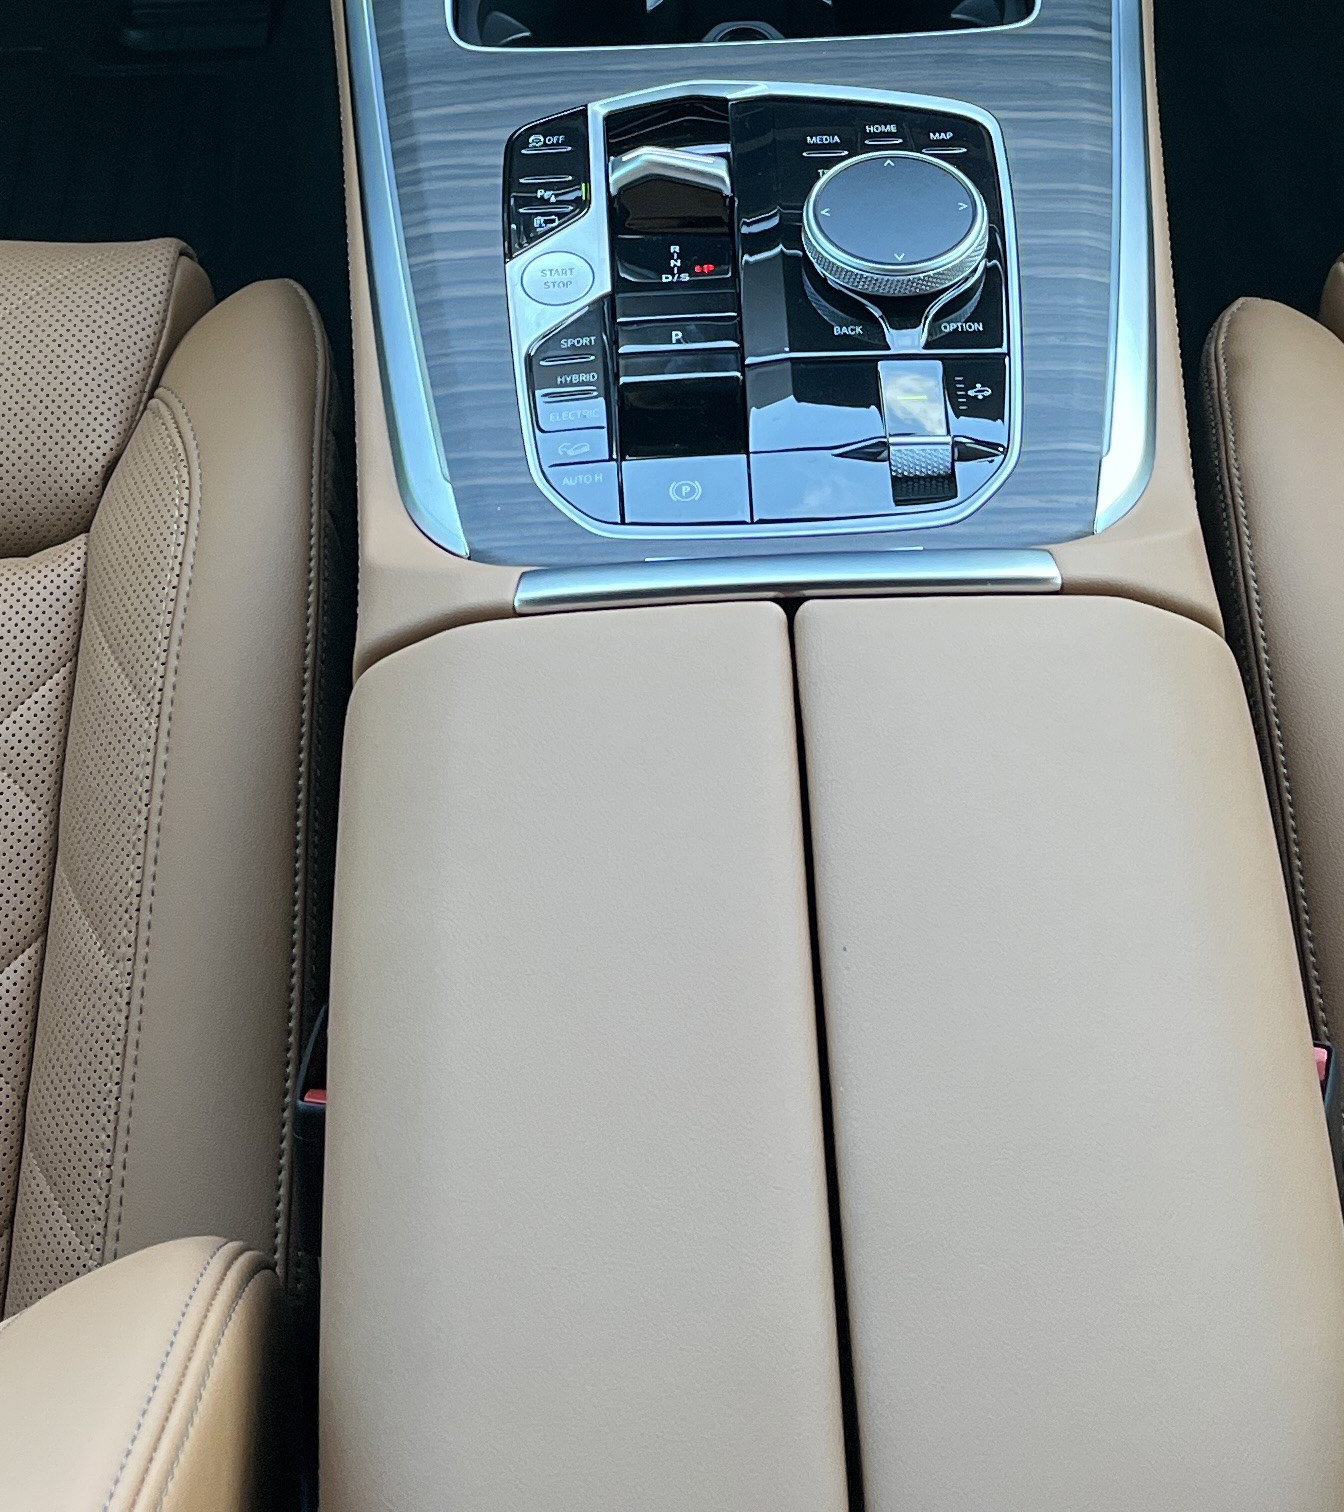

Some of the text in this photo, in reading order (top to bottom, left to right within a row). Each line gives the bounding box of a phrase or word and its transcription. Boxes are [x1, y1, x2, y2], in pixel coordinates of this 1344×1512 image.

[865, 124, 897, 134] HOME
[545, 134, 565, 145] OFF
[806, 132, 954, 145] MEDIA MAP
[670, 245, 680, 254] R
[670, 259, 681, 268] N
[540, 267, 575, 278] START
[661, 273, 690, 283] D/S
[543, 280, 573, 290] STOP
[833, 325, 863, 336] BACK
[941, 322, 984, 332] OPTION
[560, 336, 596, 349] SPORT
[671, 330, 683, 344] P
[556, 372, 599, 385] HYBRID
[549, 408, 600, 422] ELECTRIC
[562, 472, 603, 486] AUTO H
